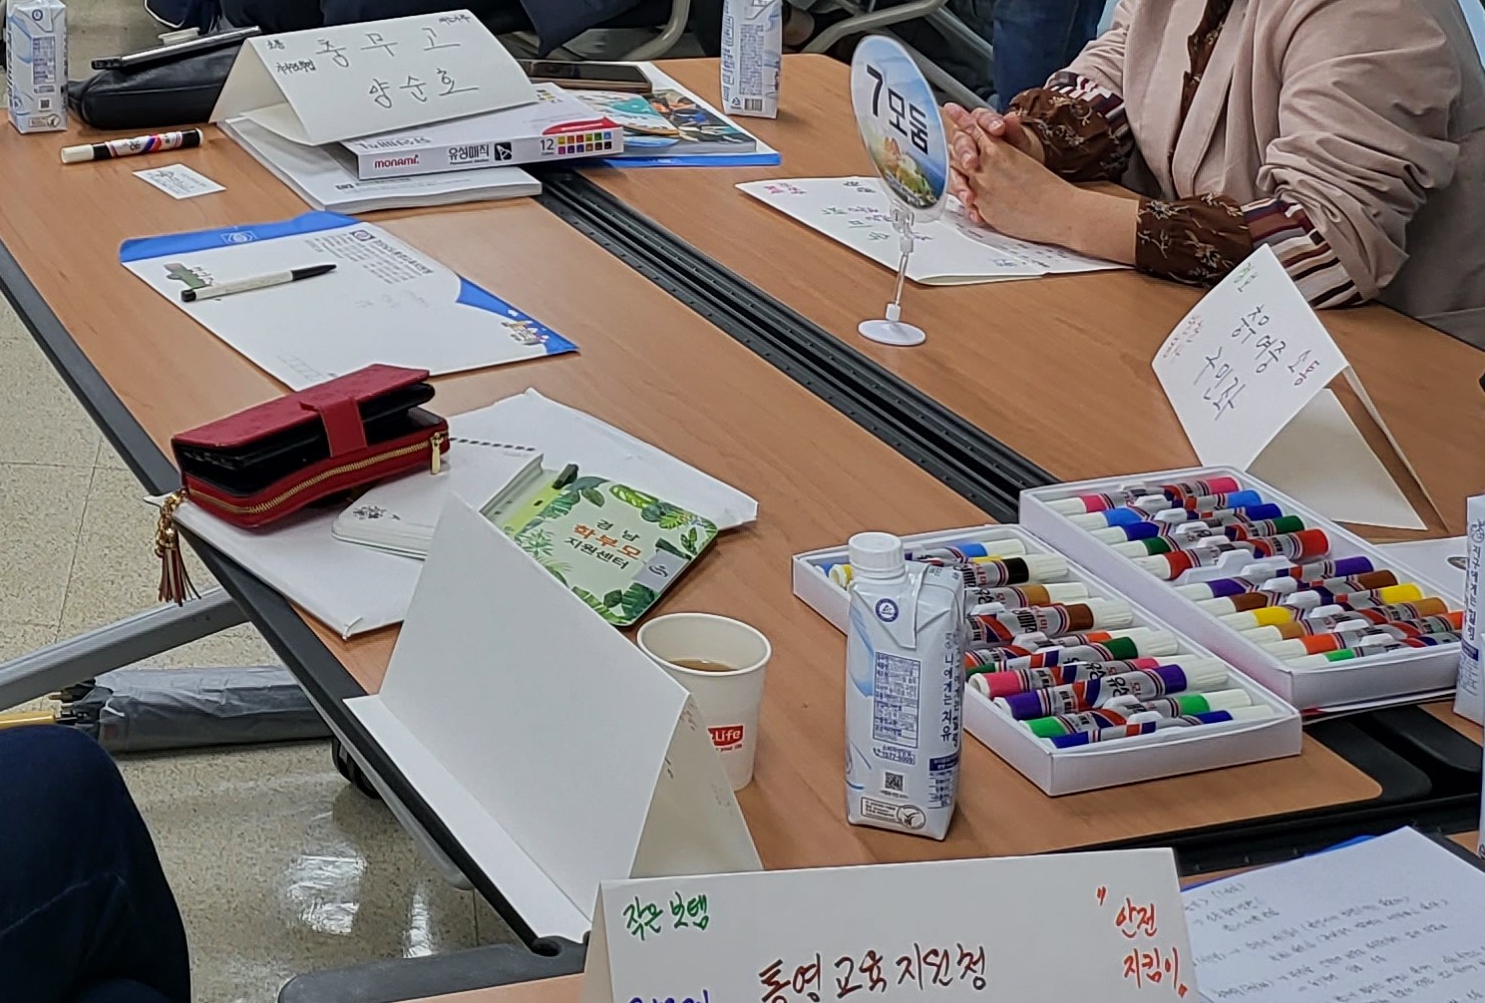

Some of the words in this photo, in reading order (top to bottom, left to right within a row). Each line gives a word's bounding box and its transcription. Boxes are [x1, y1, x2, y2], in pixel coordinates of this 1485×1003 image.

[867, 64, 928, 155] 7모둠
[448, 143, 490, 161] 유성매직
[540, 139, 554, 151] 12
[374, 154, 418, 169] monami
[564, 537, 629, 569] 지원센터
[574, 524, 642, 560] 학부모
[713, 729, 741, 742] Life
[623, 895, 663, 940] 작은
